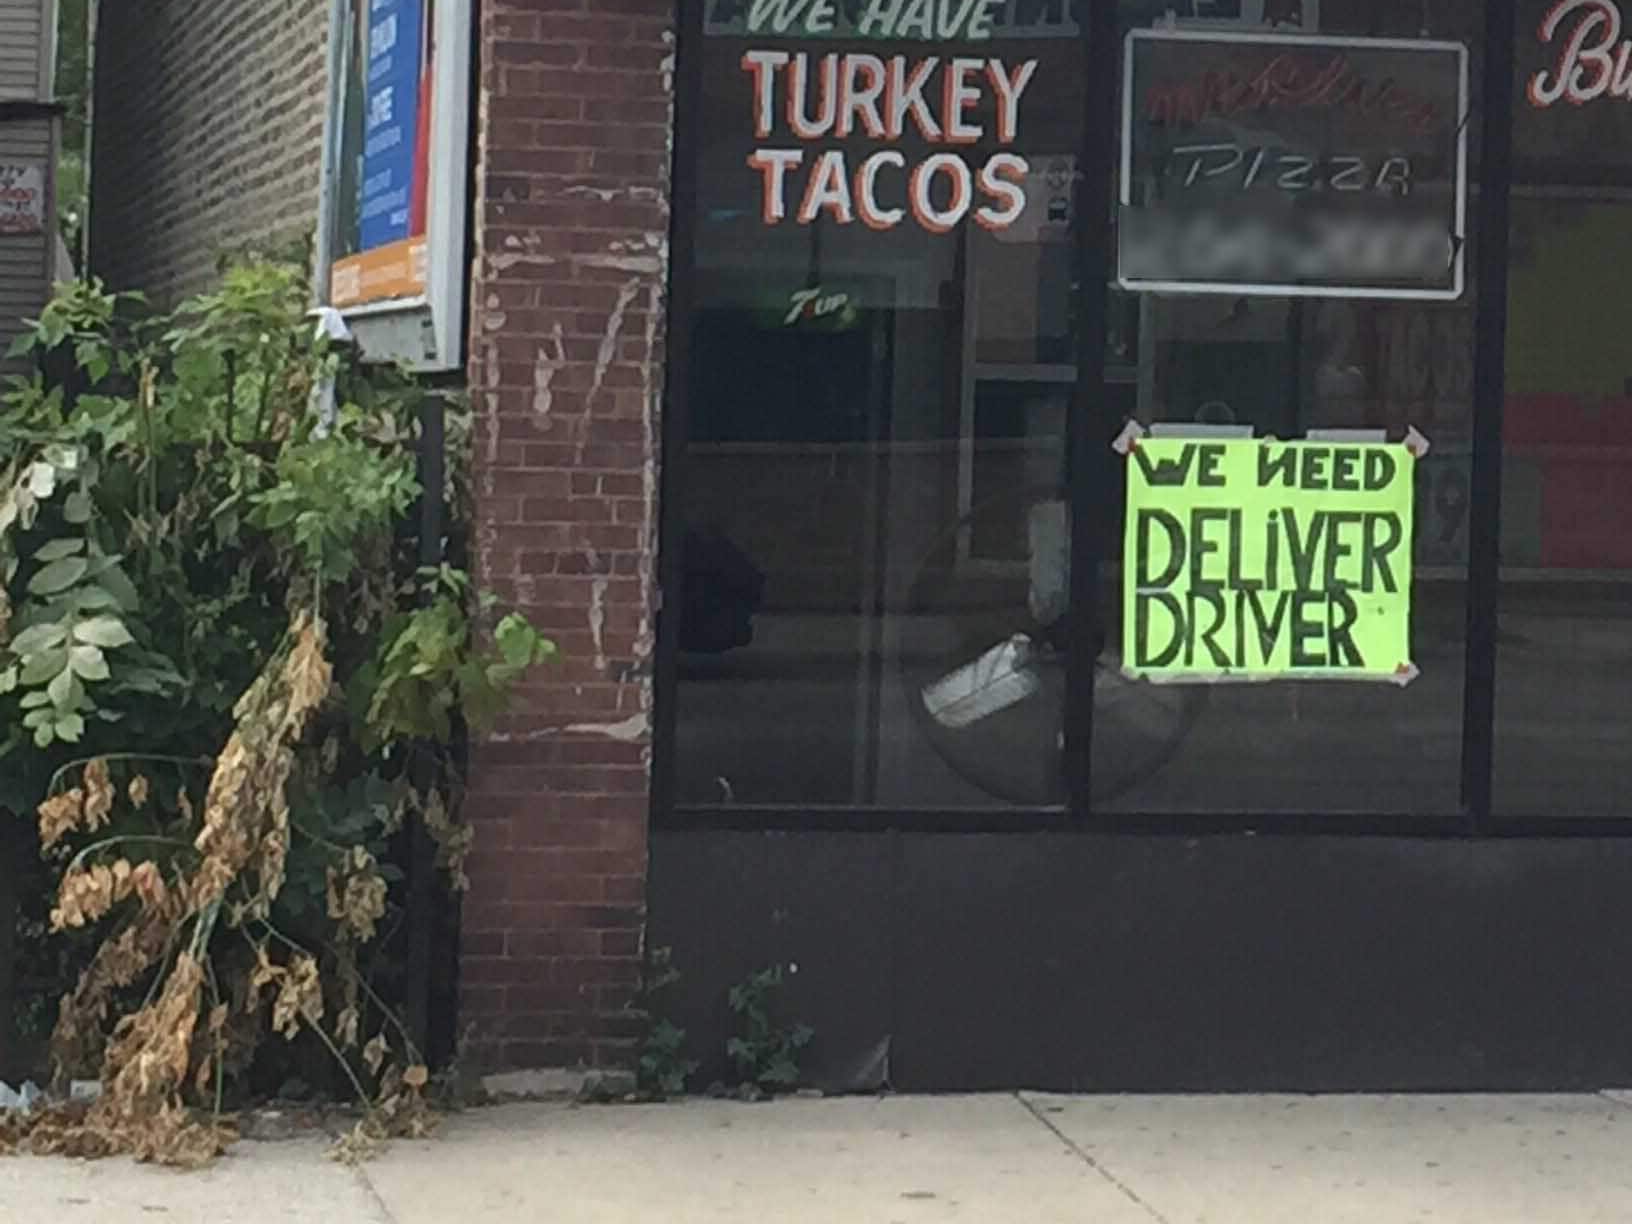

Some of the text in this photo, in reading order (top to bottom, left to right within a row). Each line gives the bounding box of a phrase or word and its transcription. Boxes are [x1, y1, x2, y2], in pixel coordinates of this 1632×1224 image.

[741, 50, 1038, 143] TURKEY
[746, 149, 1029, 232] TACOS
[1173, 143, 1410, 195] PIZZA
[1133, 443, 1396, 491] WE NEED
[1135, 589, 1366, 667] DRIVER
